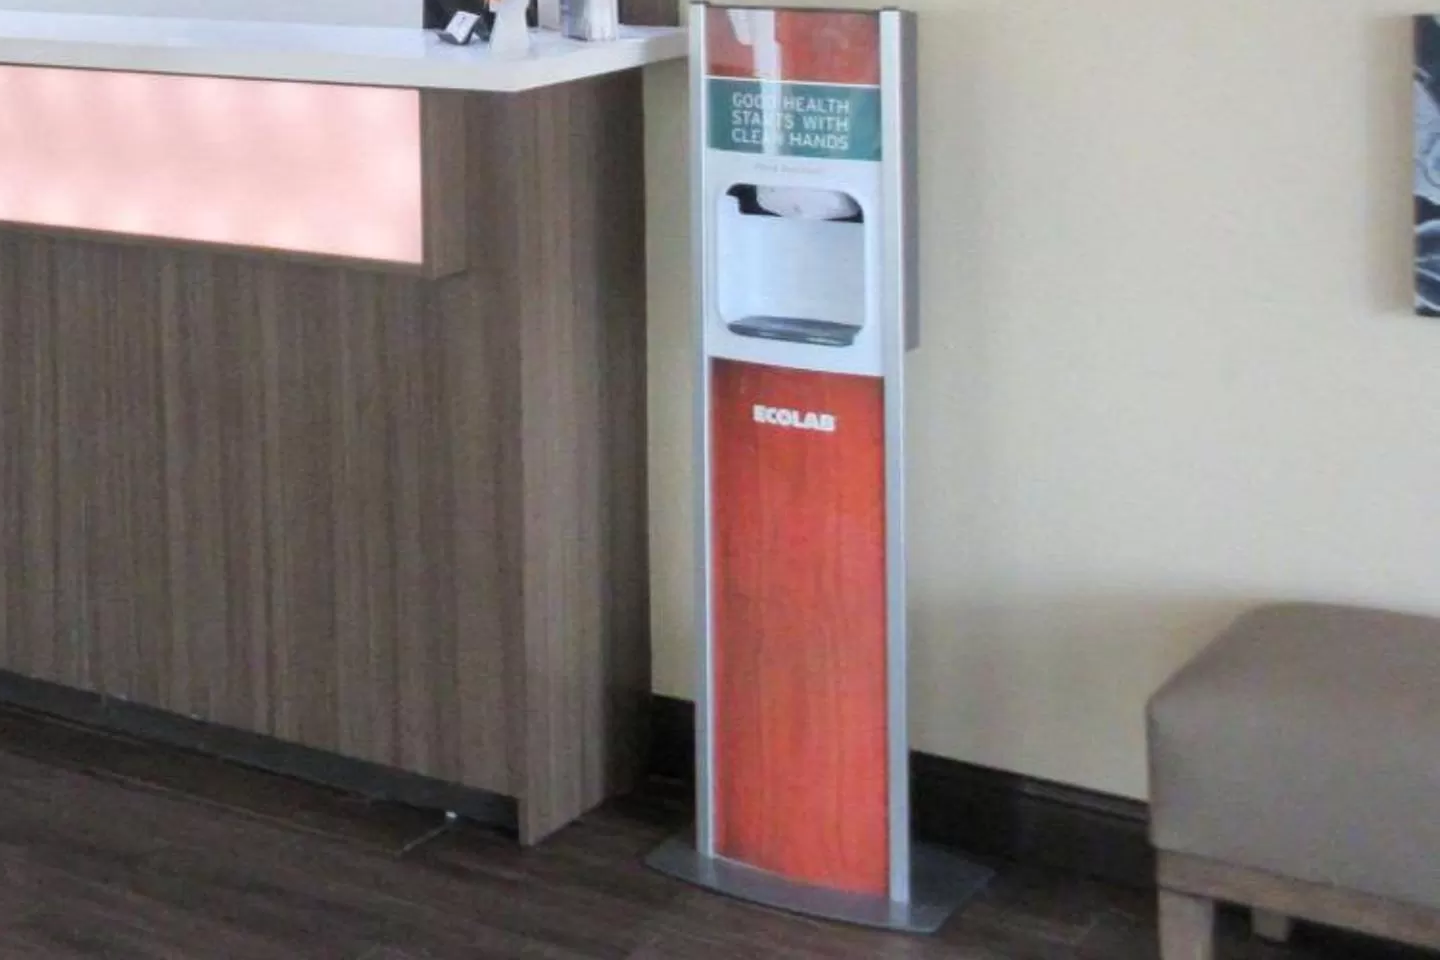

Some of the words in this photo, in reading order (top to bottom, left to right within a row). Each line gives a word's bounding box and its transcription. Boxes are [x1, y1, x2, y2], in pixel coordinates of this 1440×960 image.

[783, 95, 850, 115] HEALTH
[731, 109, 794, 130] STATS
[803, 115, 849, 132] WITH
[731, 127, 784, 147] CLE
[789, 132, 849, 151] HANDS
[753, 404, 835, 432] ECOLAB
